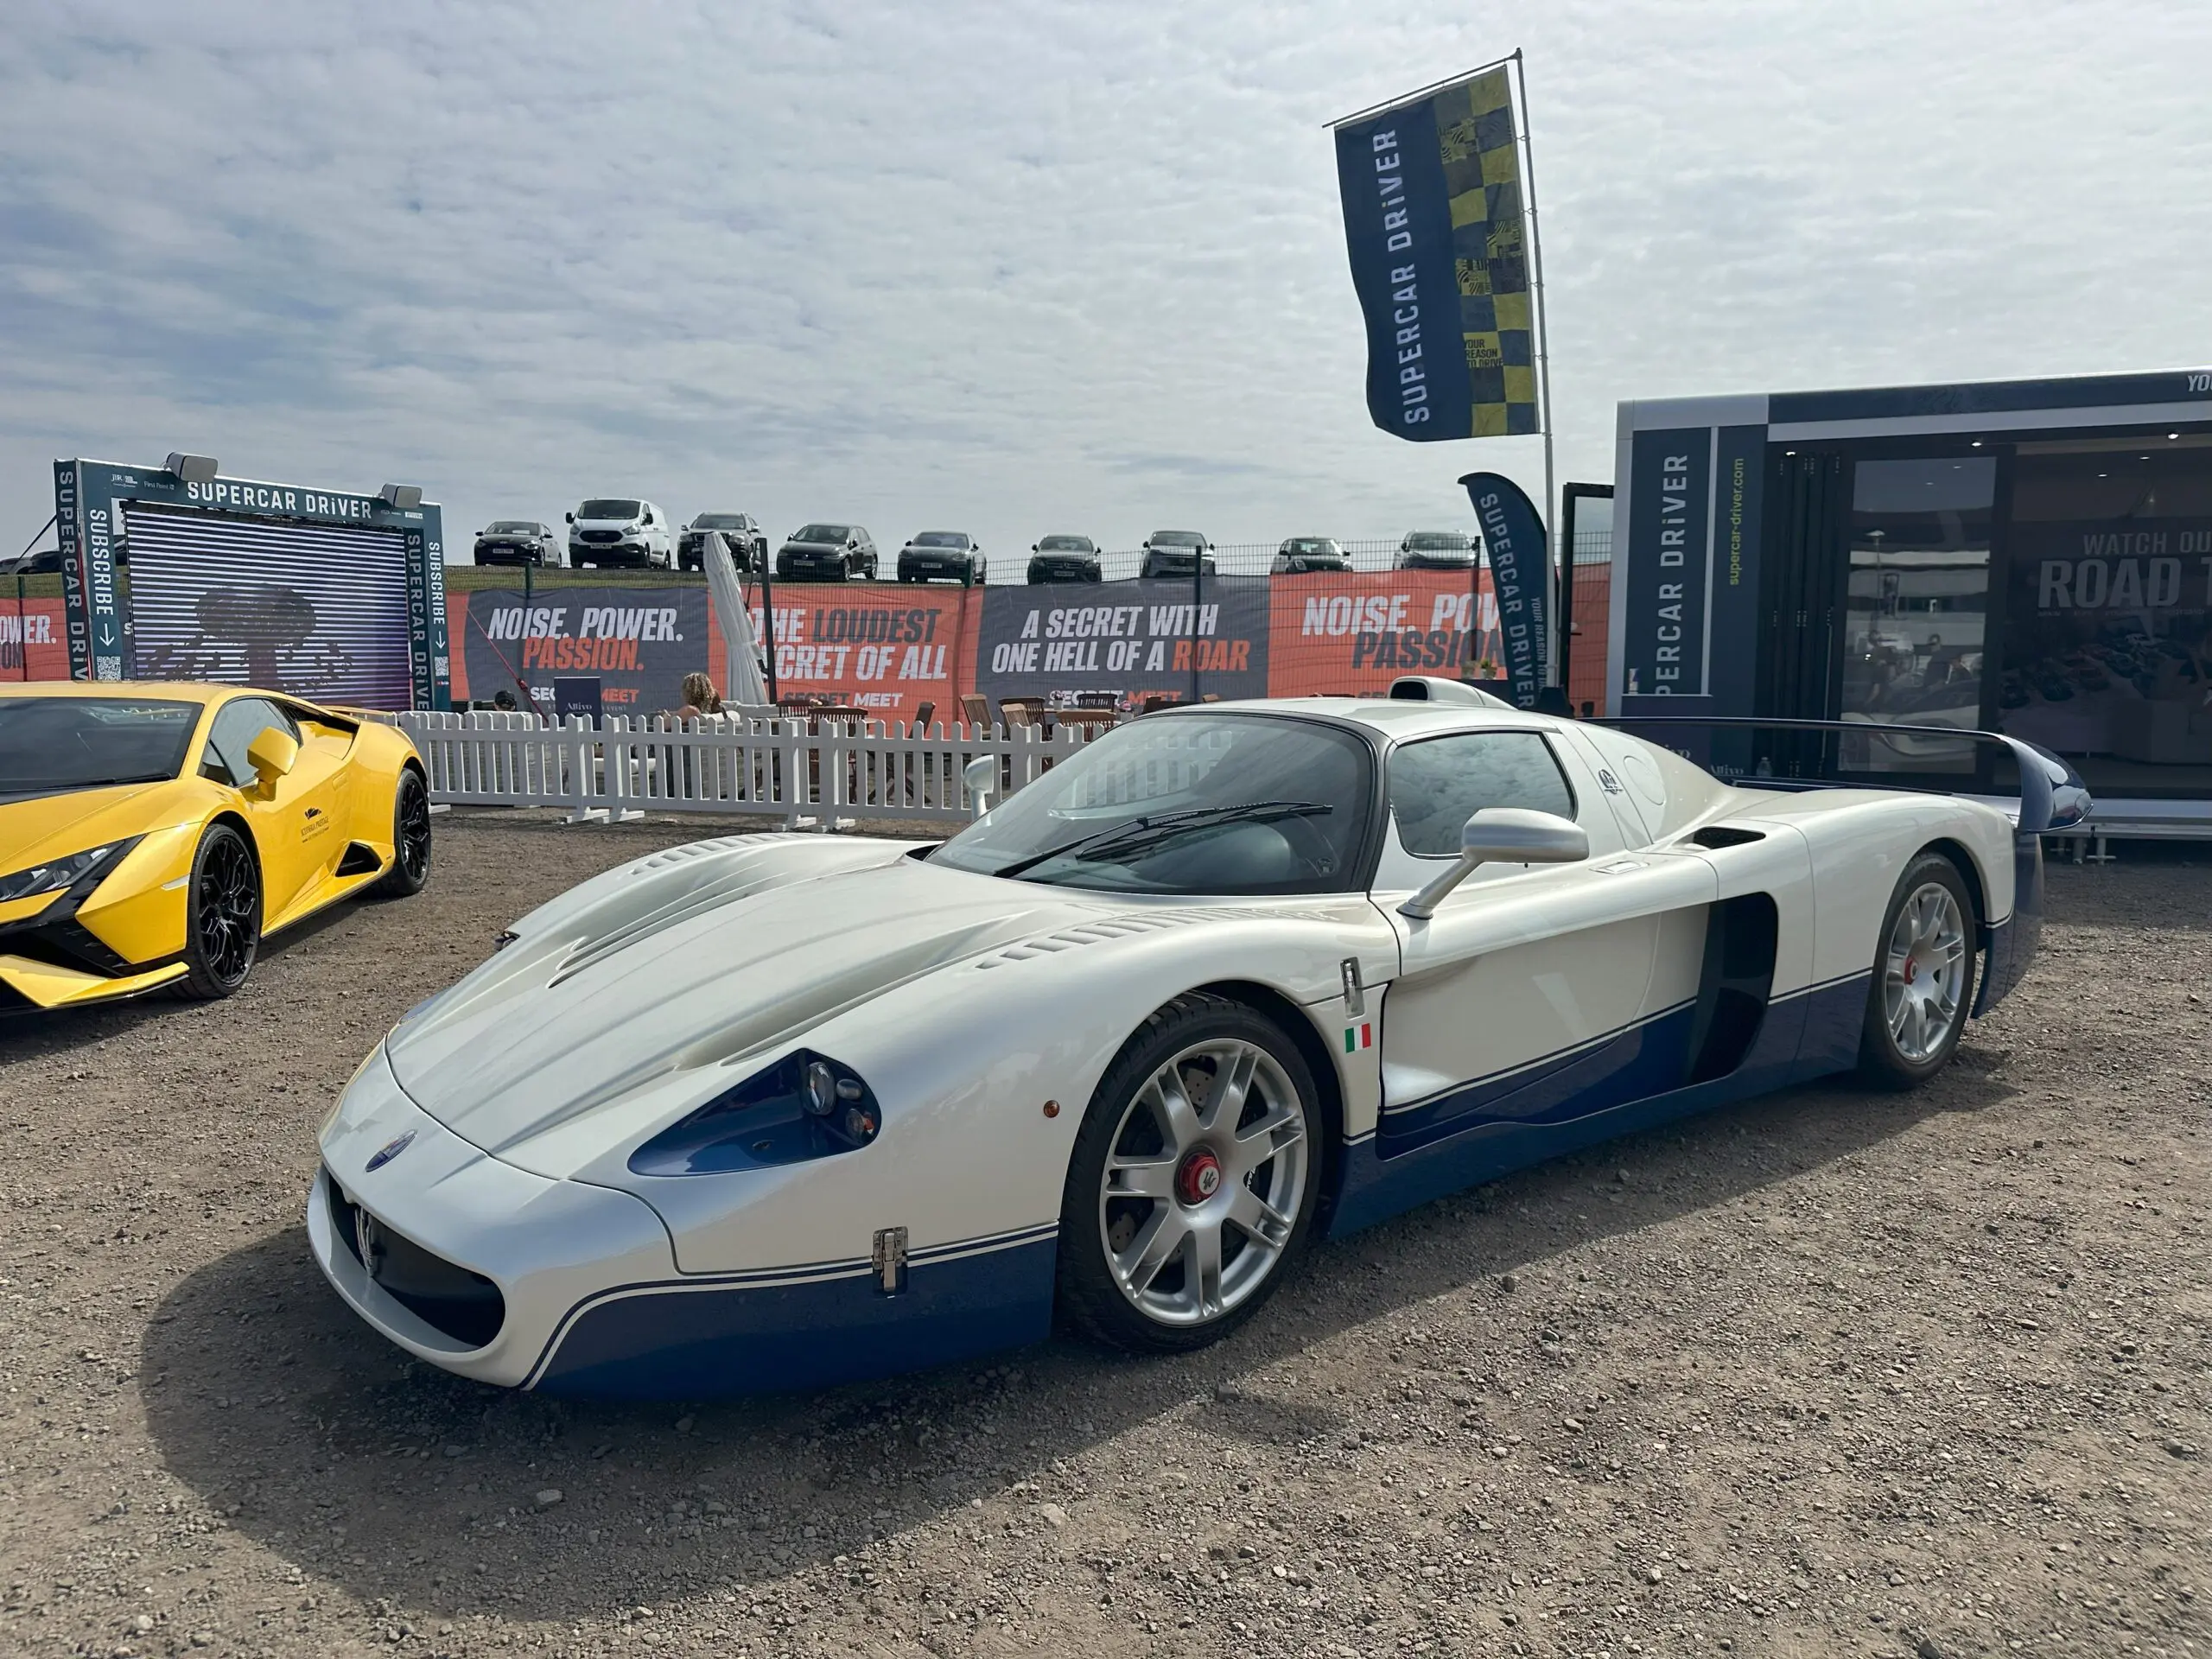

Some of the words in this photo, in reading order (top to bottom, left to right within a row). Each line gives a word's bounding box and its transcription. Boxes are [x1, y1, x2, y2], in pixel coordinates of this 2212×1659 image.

[1390, 262, 1430, 424] SUPERCAR
[2187, 374, 2212, 392] YO
[187, 481, 296, 512] SUPERCAR
[59, 470, 83, 609] SUPERCAR
[1729, 457, 1745, 587] supercar-driver.com
[1479, 493, 1523, 614] SUPERCAR
[2082, 531, 2168, 556] WATCH
[89, 509, 114, 616] SUBSCRIBE
[407, 534, 426, 642] SUPERCAR
[429, 542, 446, 626] SUBSCRIBE
[2037, 557, 2183, 608] ROAD
[487, 607, 570, 640] NOISE.
[579, 607, 683, 642] POWER.
[752, 607, 807, 643] THE
[811, 608, 943, 644] LOUDEST
[1020, 609, 1040, 639] A
[1045, 606, 1144, 639] SECRET
[1148, 604, 1220, 638] WITH
[1301, 594, 1416, 637] NOISE.
[1530, 596, 1542, 622] YOUR
[522, 636, 645, 671] PASSION.
[855, 645, 896, 681] OF
[898, 645, 948, 681] ALL
[991, 643, 1042, 673] ONE
[1043, 641, 1099, 673] HELL
[1106, 640, 1143, 672] OF
[1144, 640, 1166, 672] A
[1172, 639, 1251, 672] ROAR
[853, 692, 904, 708] MEET
[1048, 690, 1124, 707] SECT
